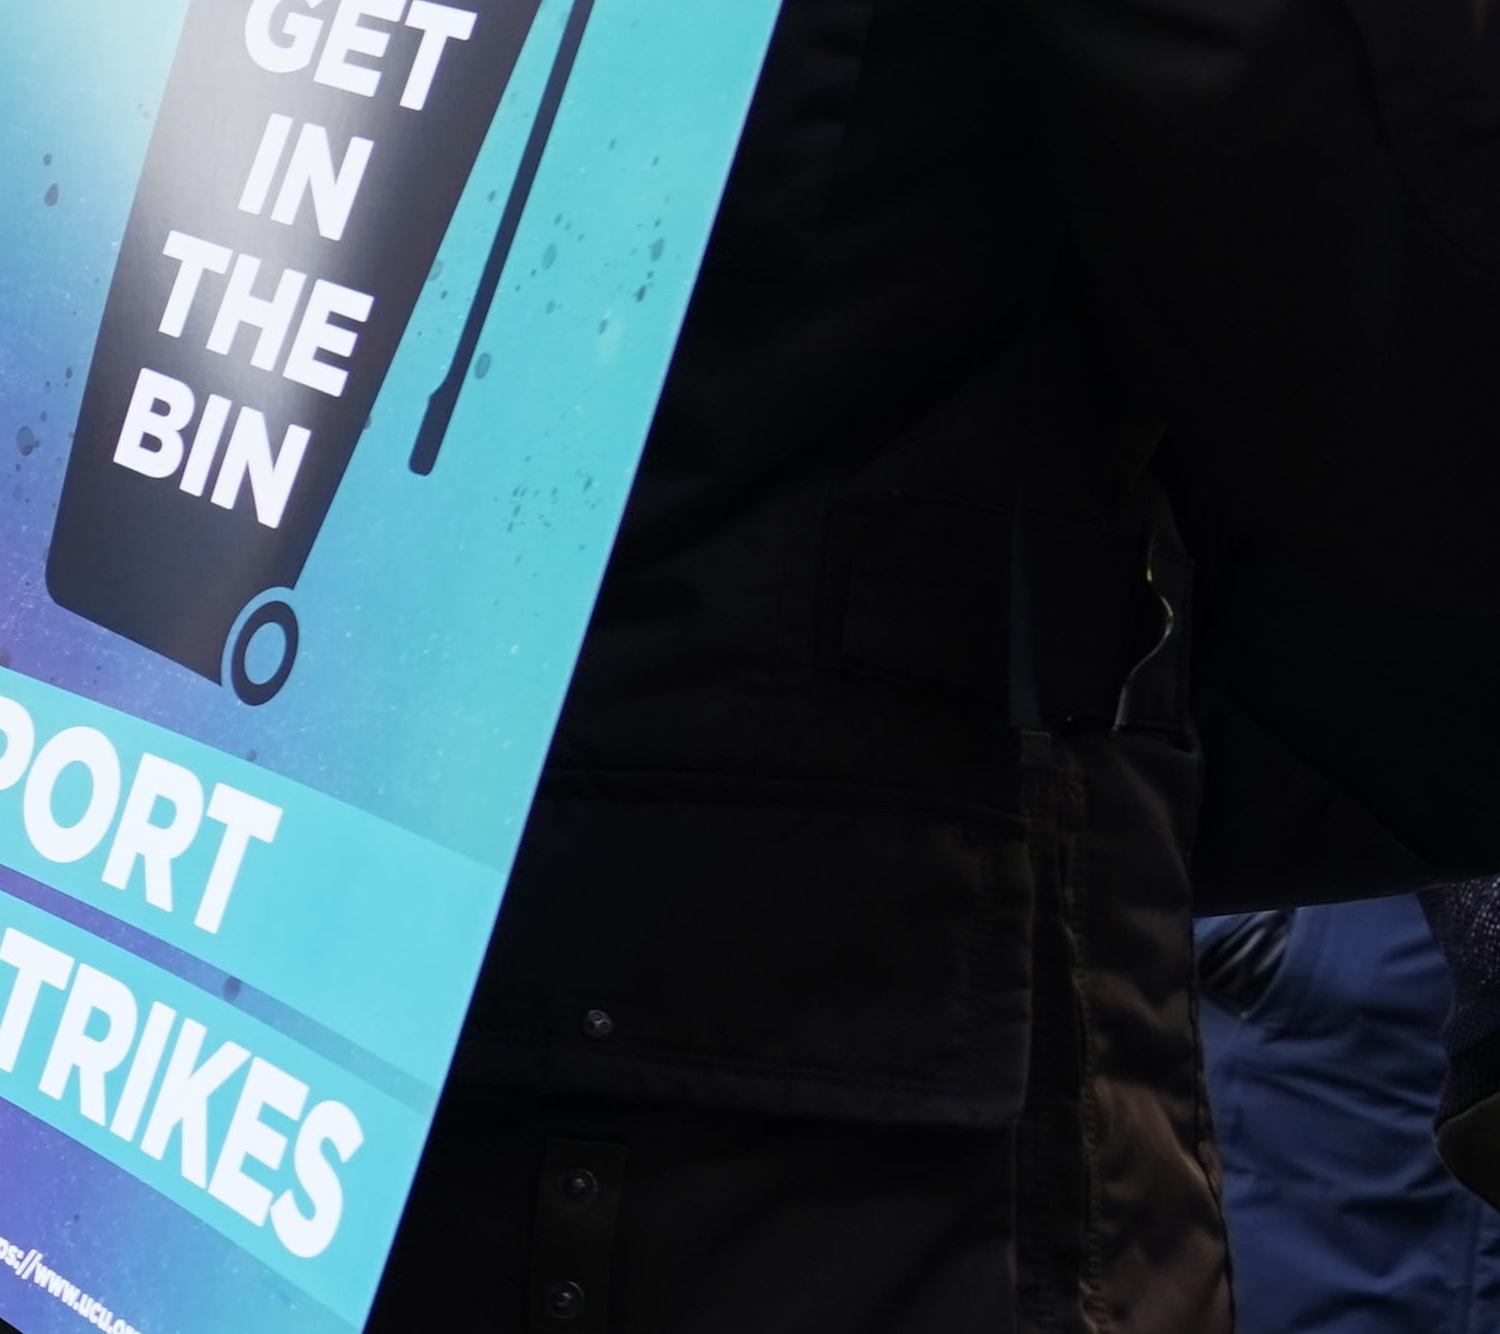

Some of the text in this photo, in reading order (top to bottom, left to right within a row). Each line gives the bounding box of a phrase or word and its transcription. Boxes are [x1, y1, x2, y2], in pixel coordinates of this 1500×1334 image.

[237, 113, 375, 242] IN
[158, 229, 375, 398] THE
[112, 367, 312, 530] BIN
